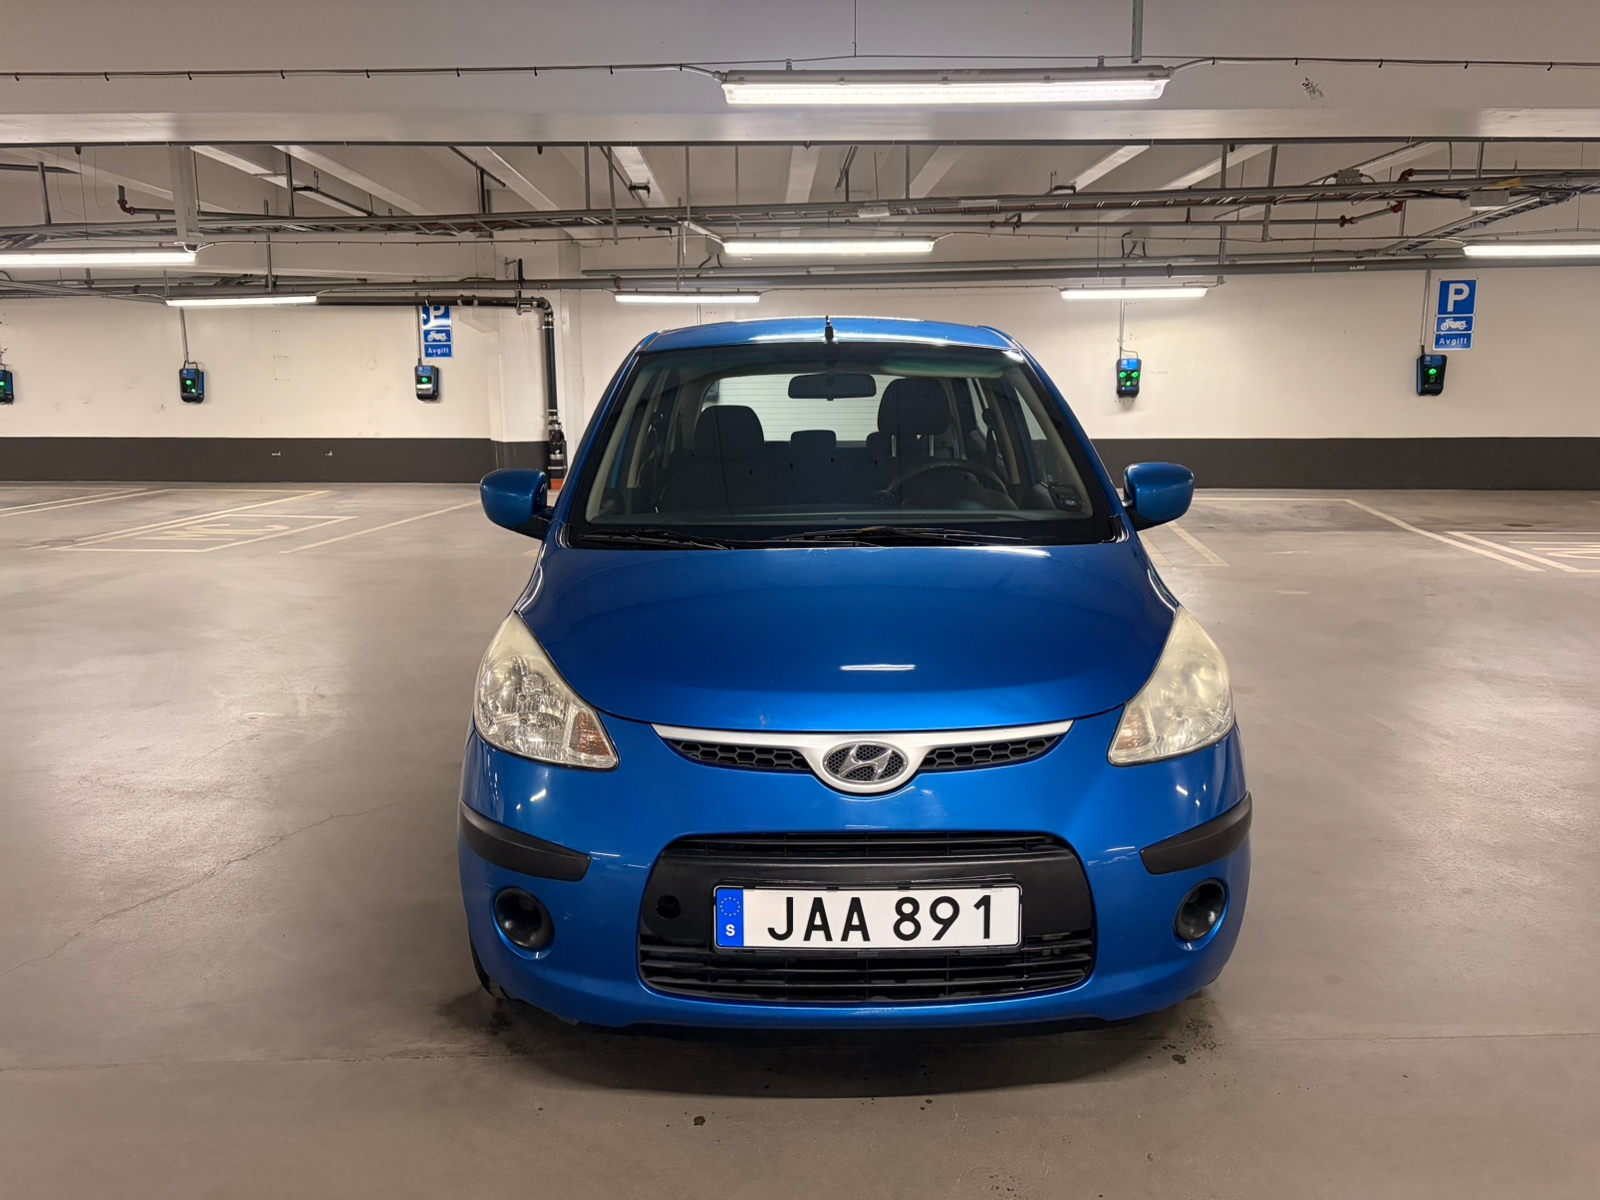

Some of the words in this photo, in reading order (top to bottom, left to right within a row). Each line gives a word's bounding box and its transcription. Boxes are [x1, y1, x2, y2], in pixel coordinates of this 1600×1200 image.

[1447, 283, 1470, 312] P
[1438, 337, 1467, 346] Avgift
[427, 347, 449, 355] Avgift
[767, 896, 871, 941] JAA
[893, 895, 993, 941] 891
[725, 924, 736, 936] S
